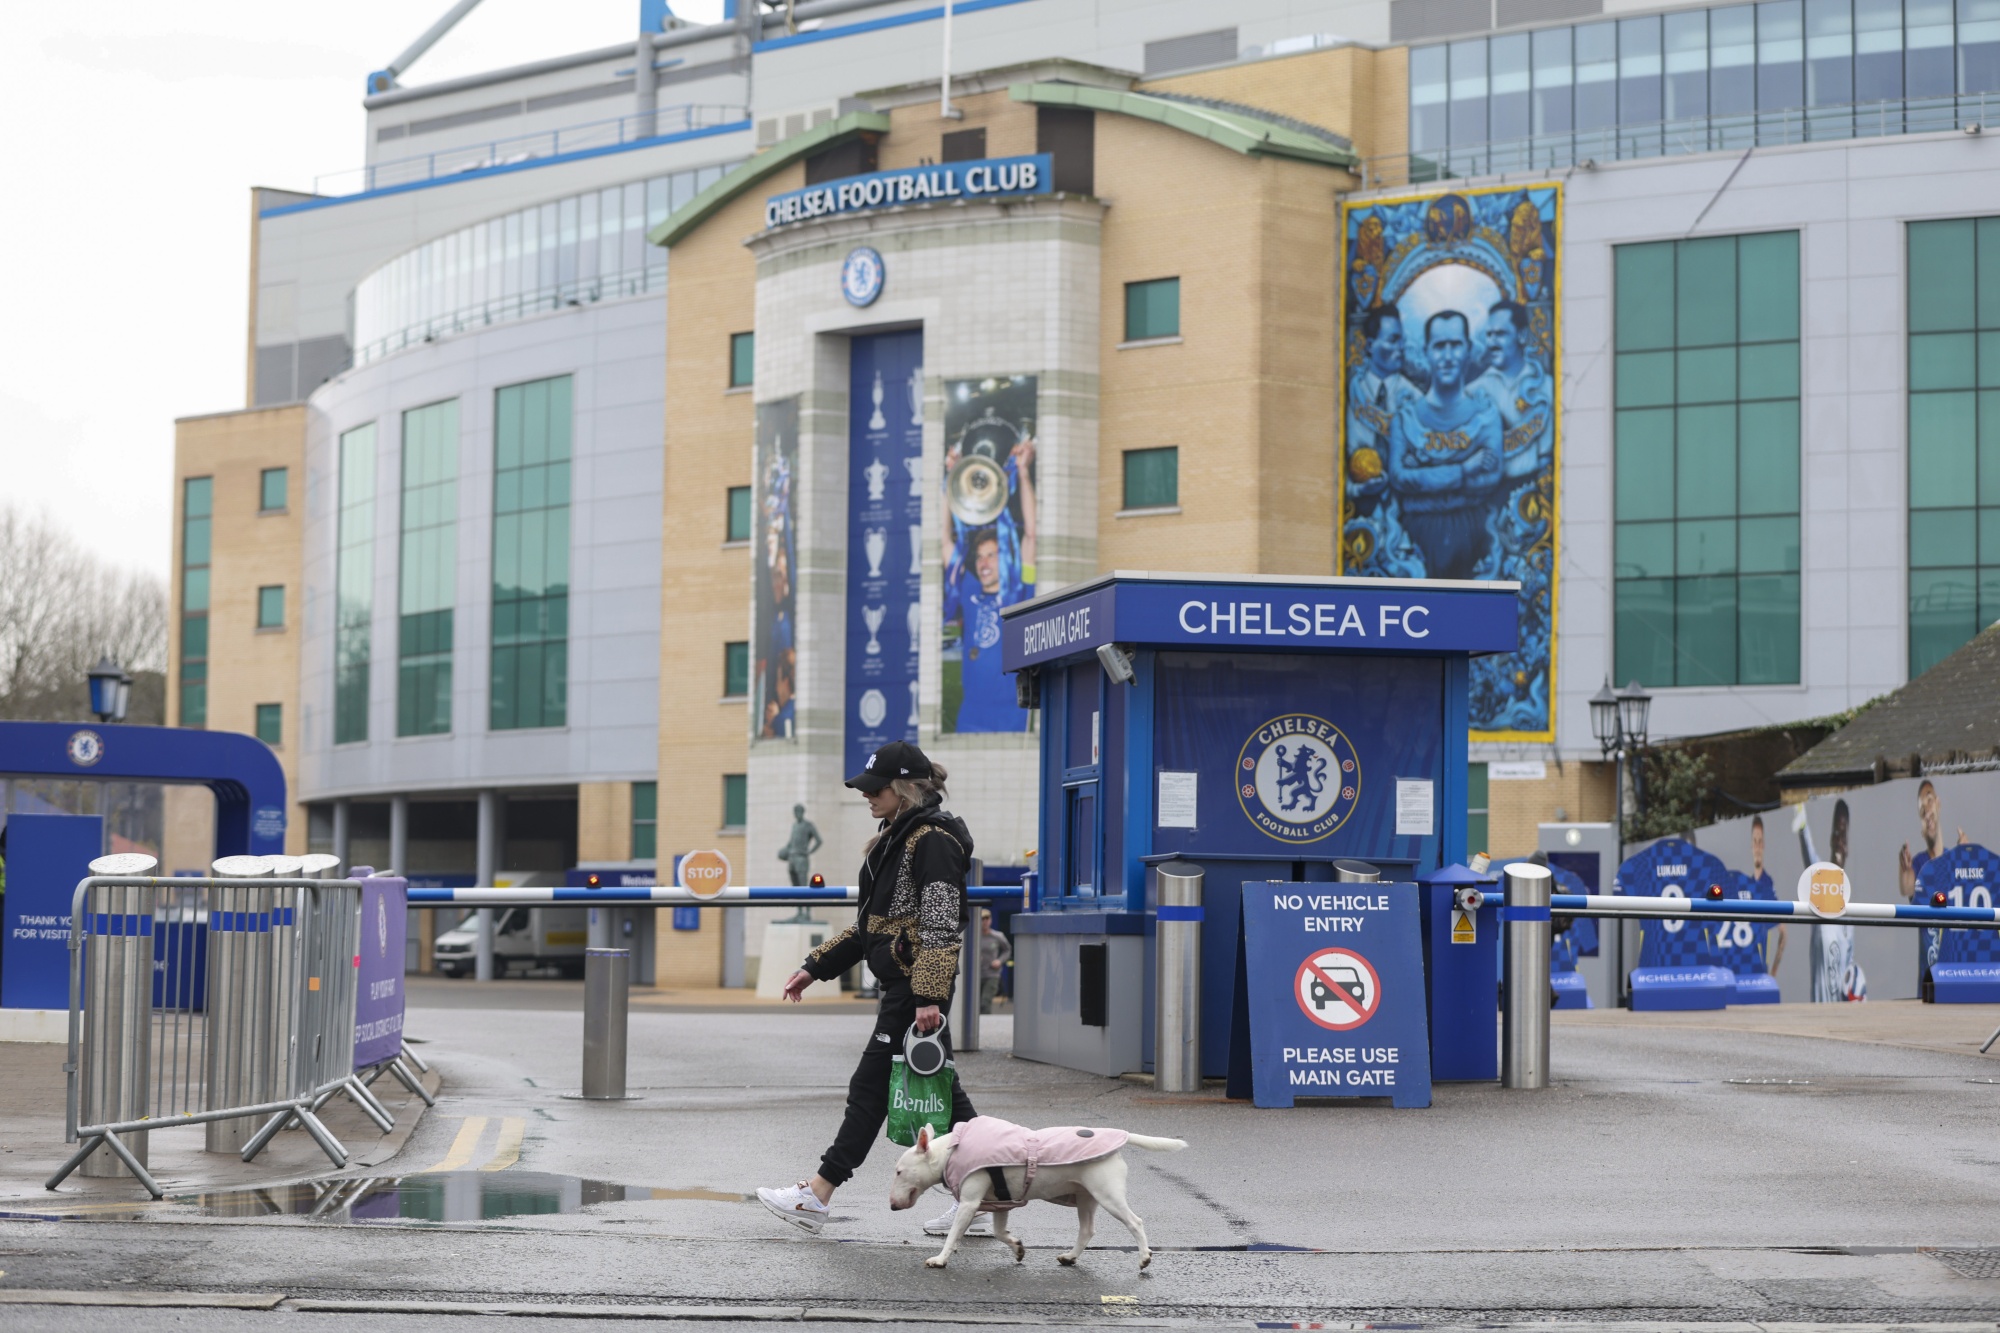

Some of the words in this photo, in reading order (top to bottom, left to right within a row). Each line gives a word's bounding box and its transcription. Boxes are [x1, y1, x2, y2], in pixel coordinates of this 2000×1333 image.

[766, 188, 836, 226] CHELSEA
[838, 170, 961, 210] FOOTBALL
[965, 162, 1038, 194] CLUB
[1179, 600, 1366, 637] CHELSEA
[1379, 605, 1430, 638] FC
[1024, 615, 1067, 656] BRITANNIA
[1068, 607, 1091, 643] GATE
[1258, 718, 1339, 748] CHELSEA
[1256, 812, 1309, 837] FOOTBALL
[1313, 813, 1340, 833] CLUB
[687, 867, 724, 879] STOP
[1656, 864, 1688, 877] LUKAKU
[1955, 867, 1984, 879] PULISIC
[1274, 895, 1303, 910] NO
[1308, 895, 1390, 911] VEHICLE
[19, 914, 57, 926] THANK
[1304, 917, 1364, 932] ENTRY
[13, 928, 37, 939] FOR
[39, 929, 87, 940] VISITIG
[1638, 972, 1717, 983] #CHELSEAFC
[1283, 1047, 1356, 1063] PLEASE
[1361, 1047, 1399, 1063] USE
[1289, 1069, 1340, 1085] MAIN
[1346, 1069, 1396, 1086] GATE
